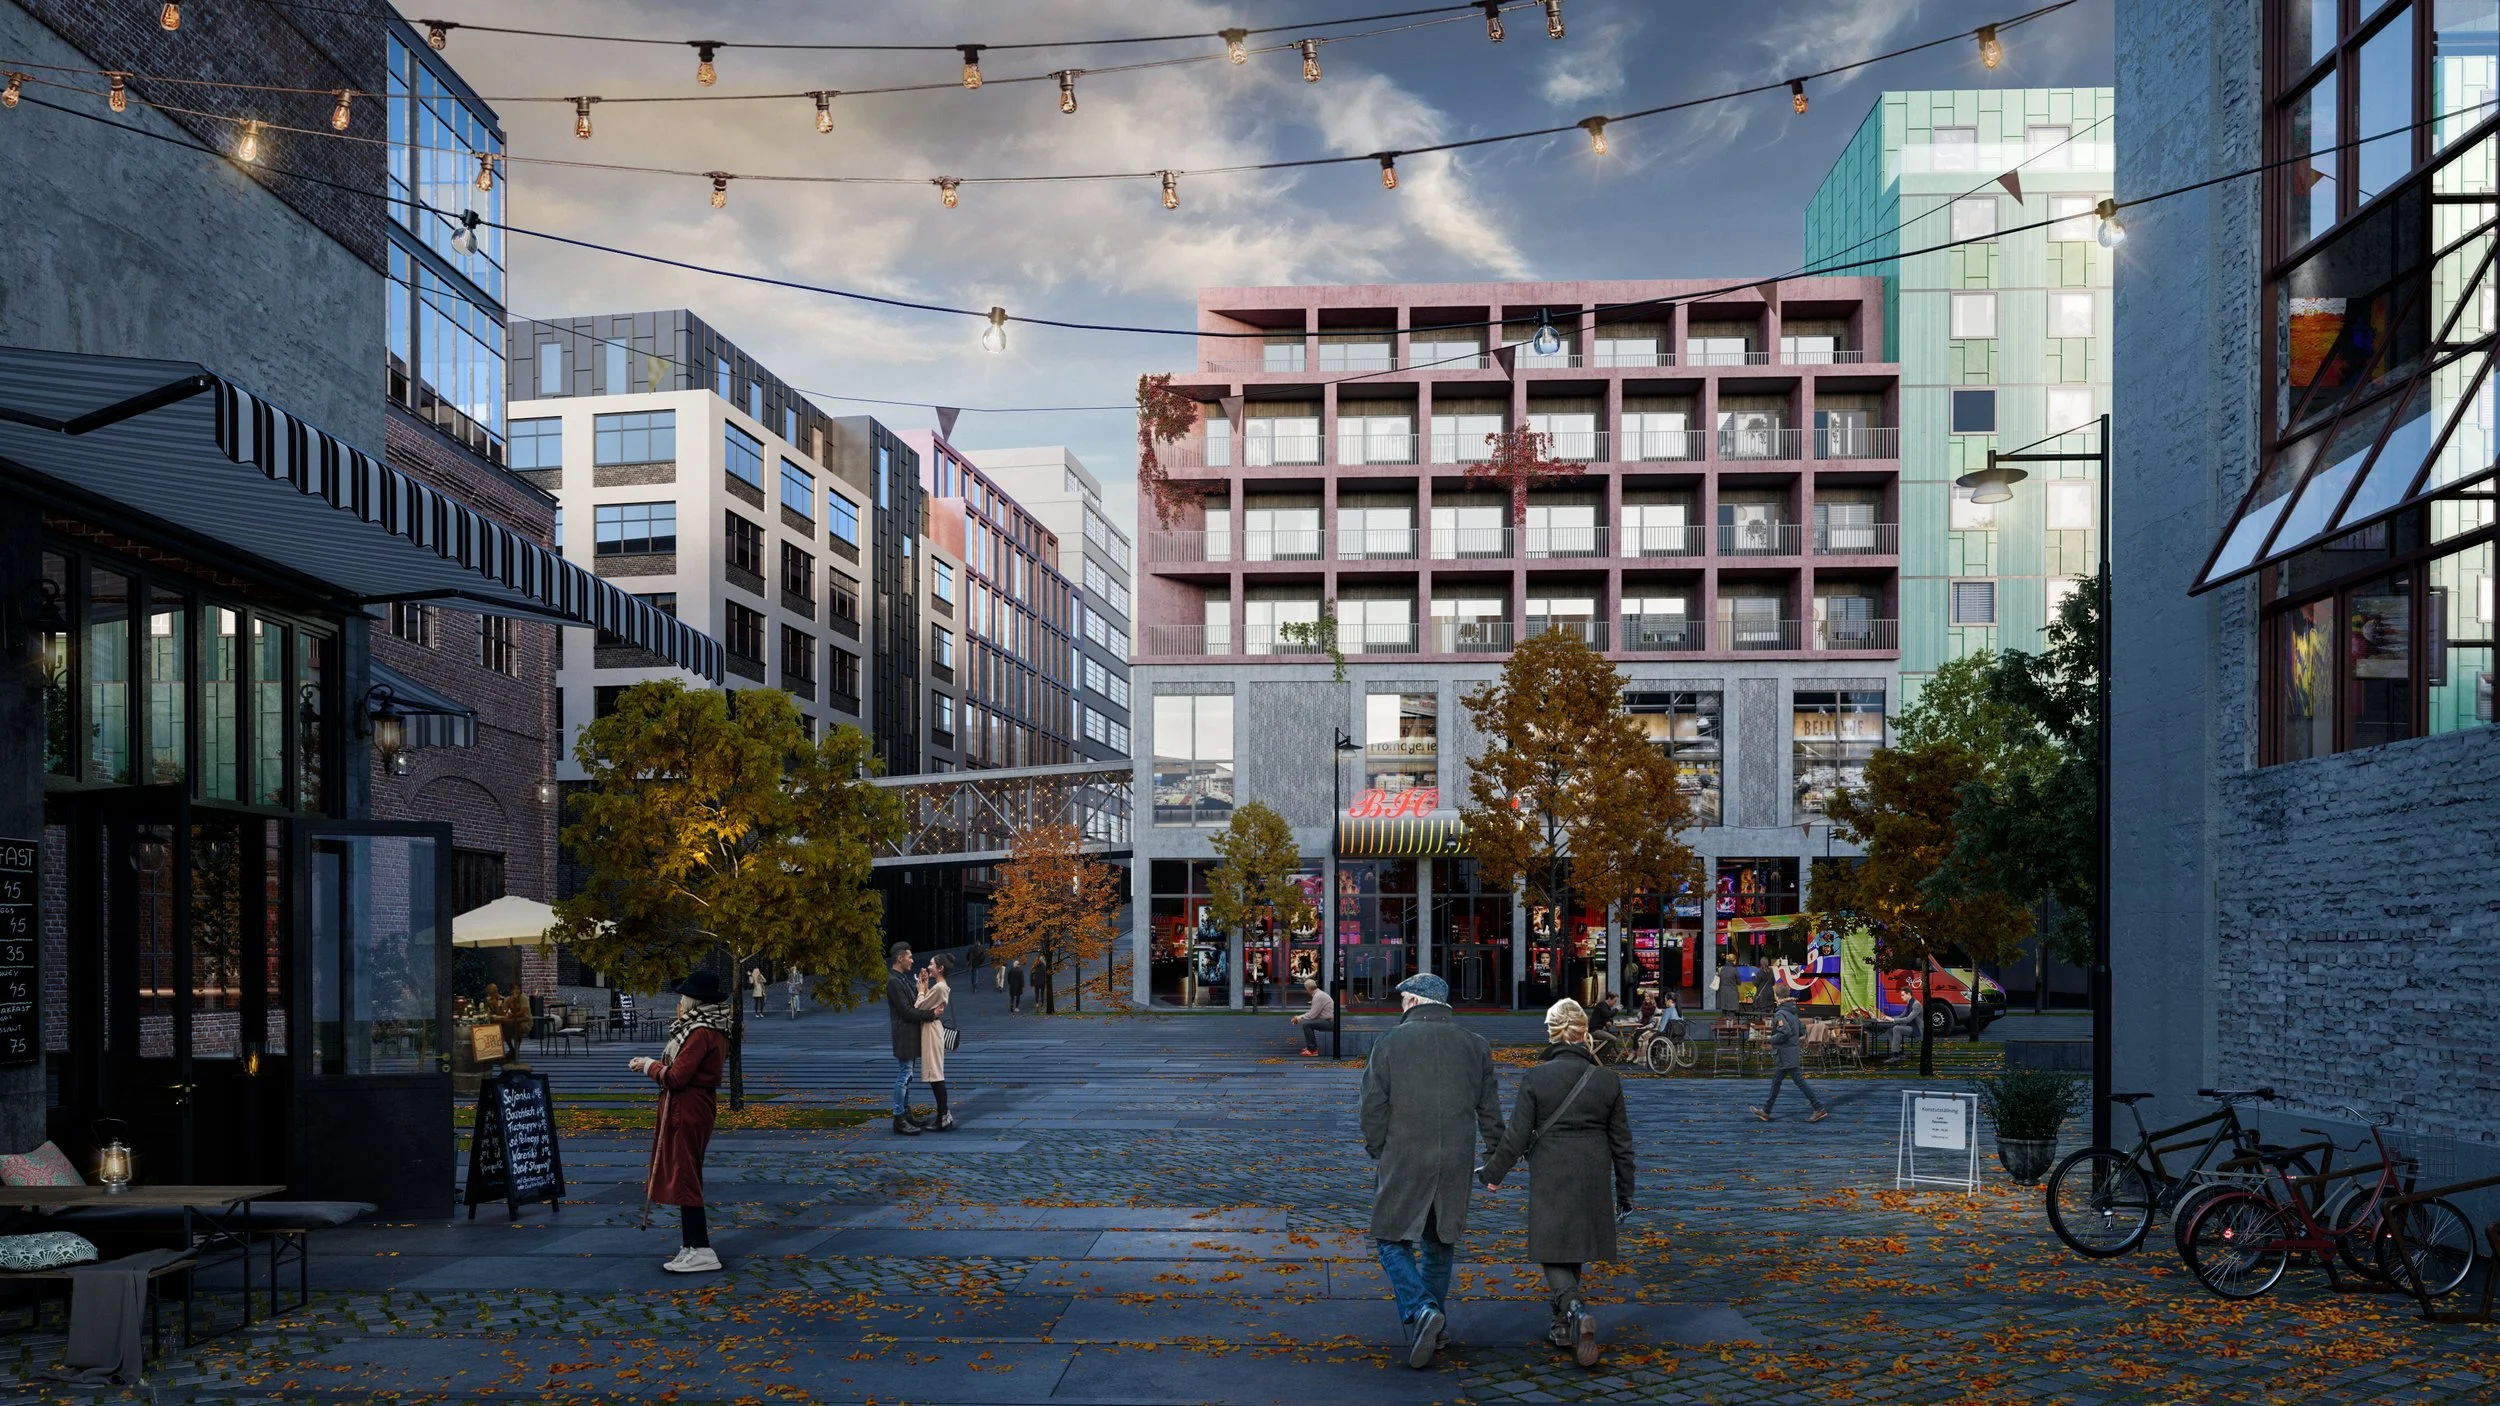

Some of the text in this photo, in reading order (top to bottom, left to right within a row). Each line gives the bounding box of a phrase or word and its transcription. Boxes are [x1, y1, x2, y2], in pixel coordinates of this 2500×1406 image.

[1804, 720, 1864, 736] BELLVUE
[1370, 741, 1437, 755] Fromageie
[1348, 788, 1440, 819] BIO
[4, 880, 21, 899] 45
[10, 917, 26, 933] 45
[6, 945, 25, 961] 35
[10, 982, 26, 998] 45
[10, 1038, 26, 1054] 75
